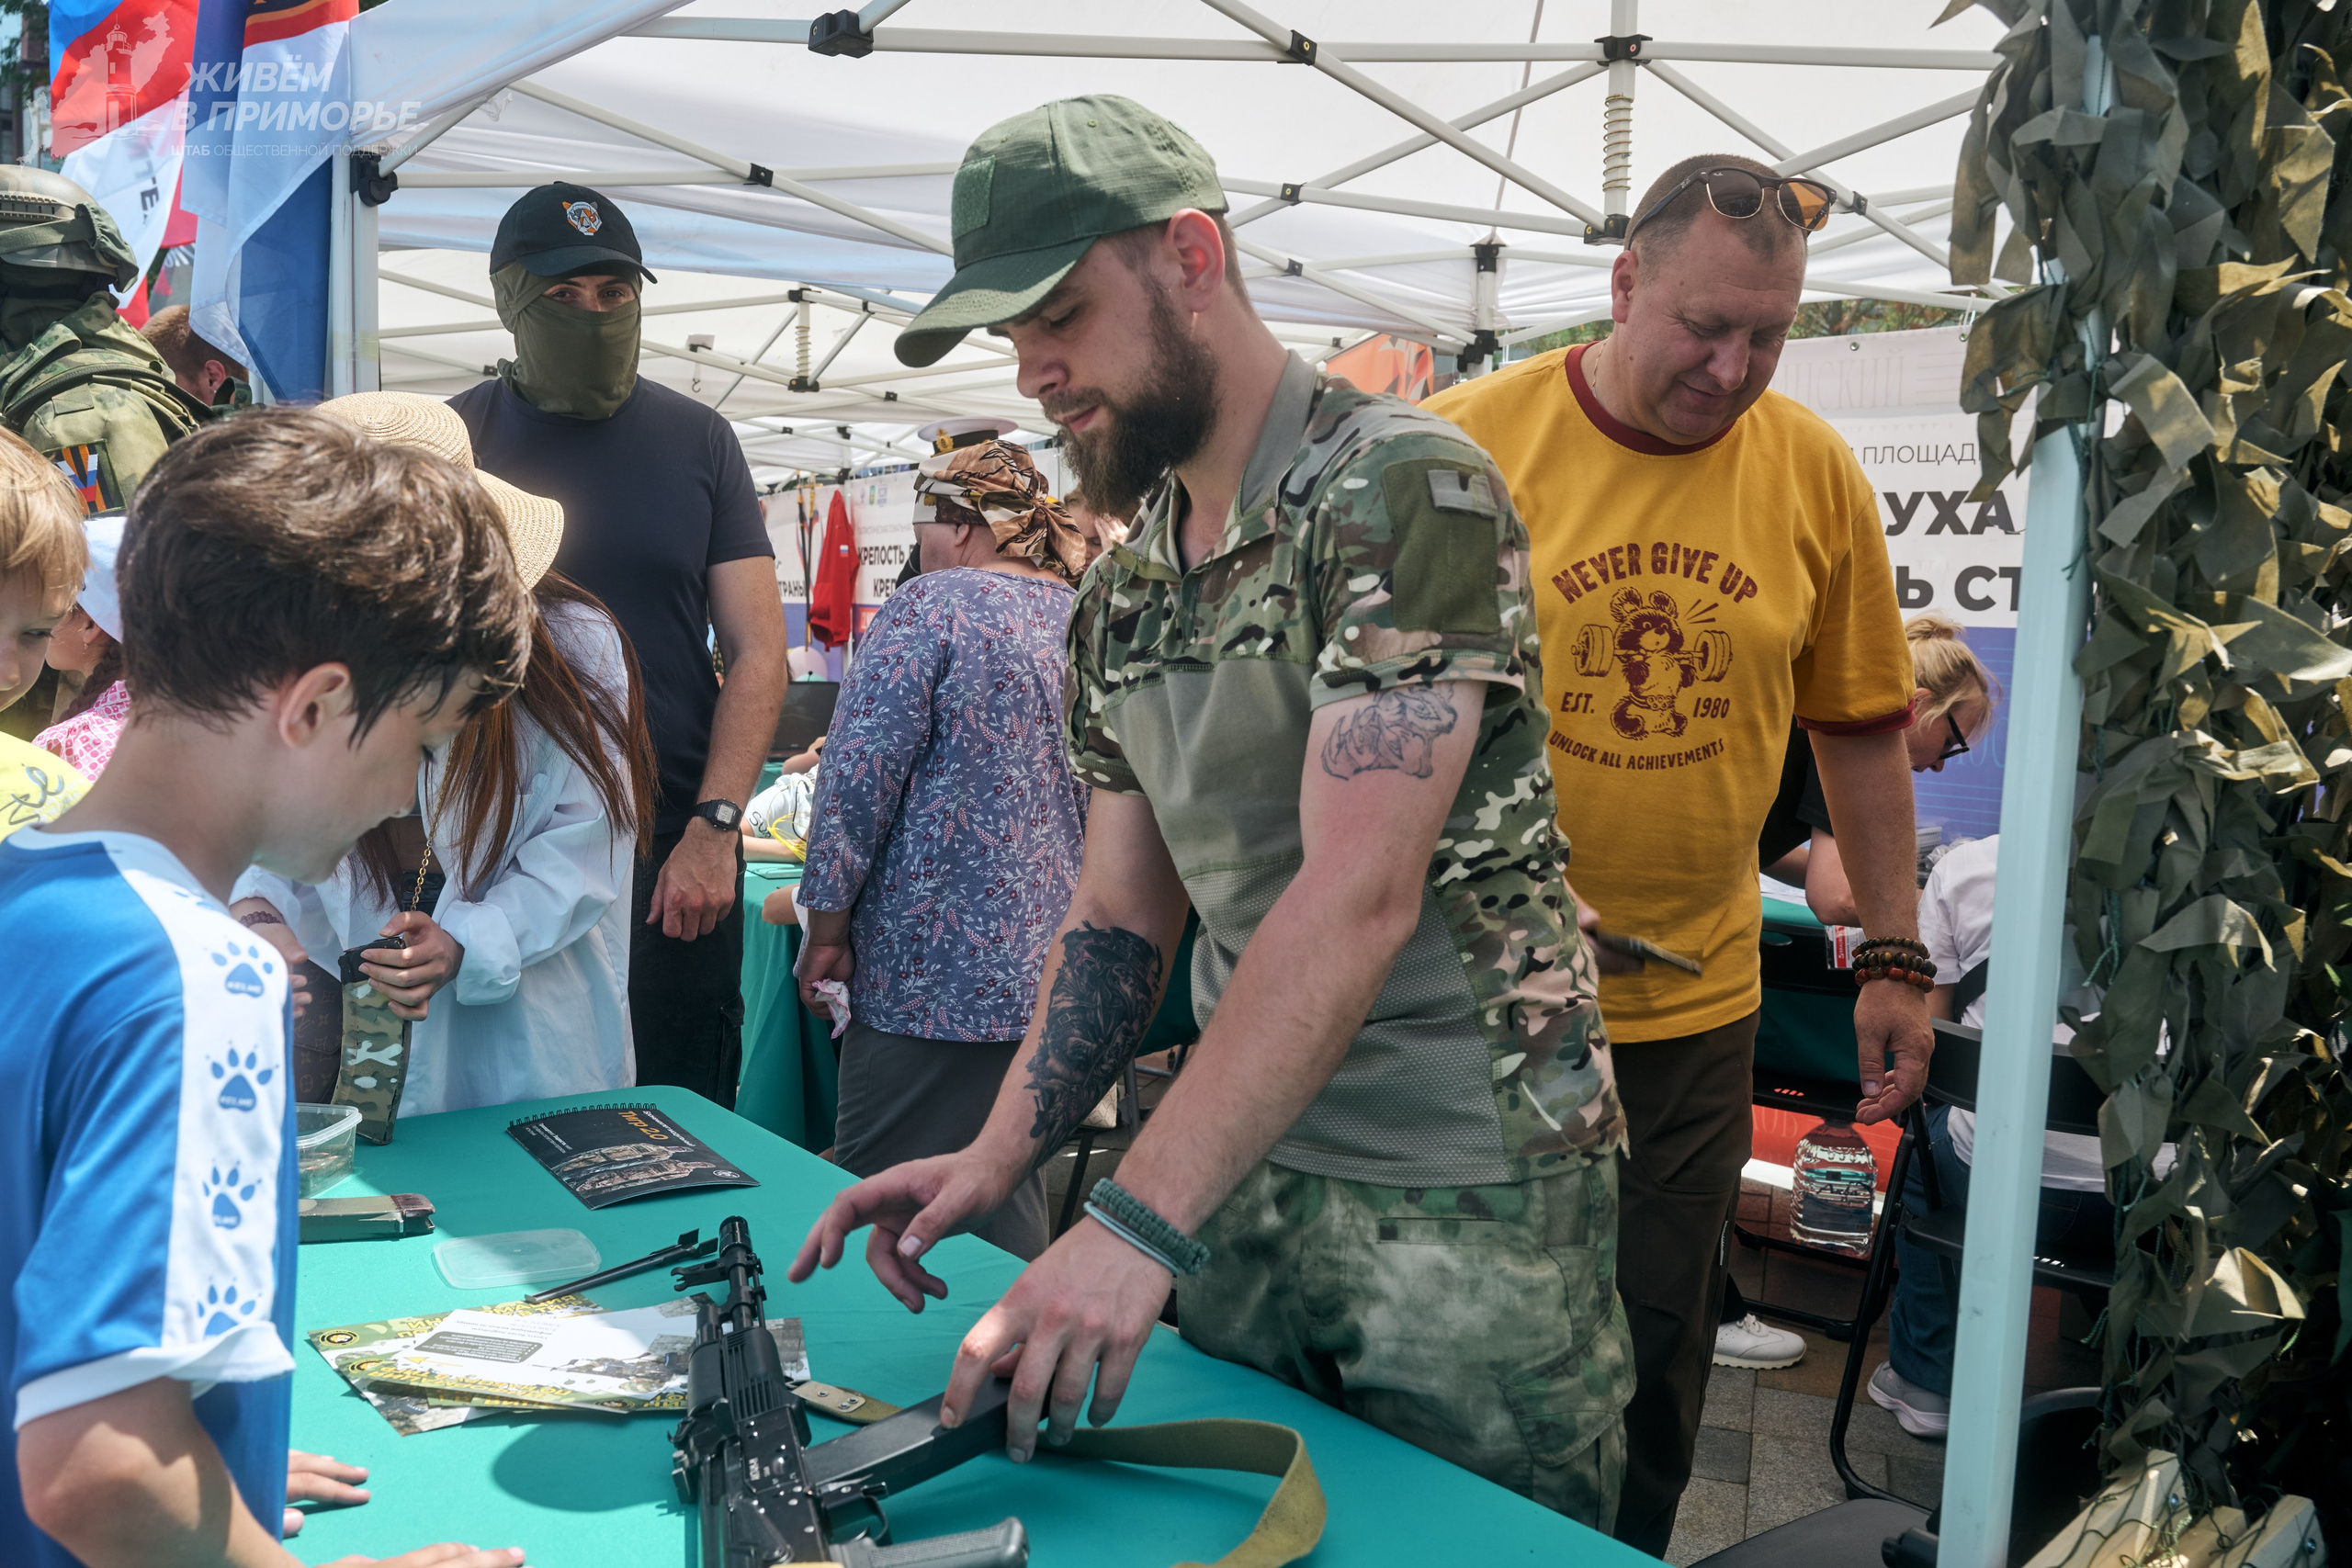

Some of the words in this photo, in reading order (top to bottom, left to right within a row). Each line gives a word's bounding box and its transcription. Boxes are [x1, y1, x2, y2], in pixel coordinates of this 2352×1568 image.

[1862, 443, 1982, 466] ПЛОЩАД
[1873, 490, 2020, 536] УХА
[857, 545, 905, 566] КРЕПОСТЬ
[1551, 543, 1642, 604] NEVER
[1651, 541, 1720, 584] GIVE
[1719, 561, 1758, 604] UP
[1560, 692, 1595, 714] EST.
[1692, 697, 1730, 718] 1980
[1549, 731, 1598, 762] UNLOCK
[1600, 750, 1622, 769] ALL
[1626, 738, 1724, 771] ACHIEVEMENTS
[639, 1127, 669, 1140] 2.0
